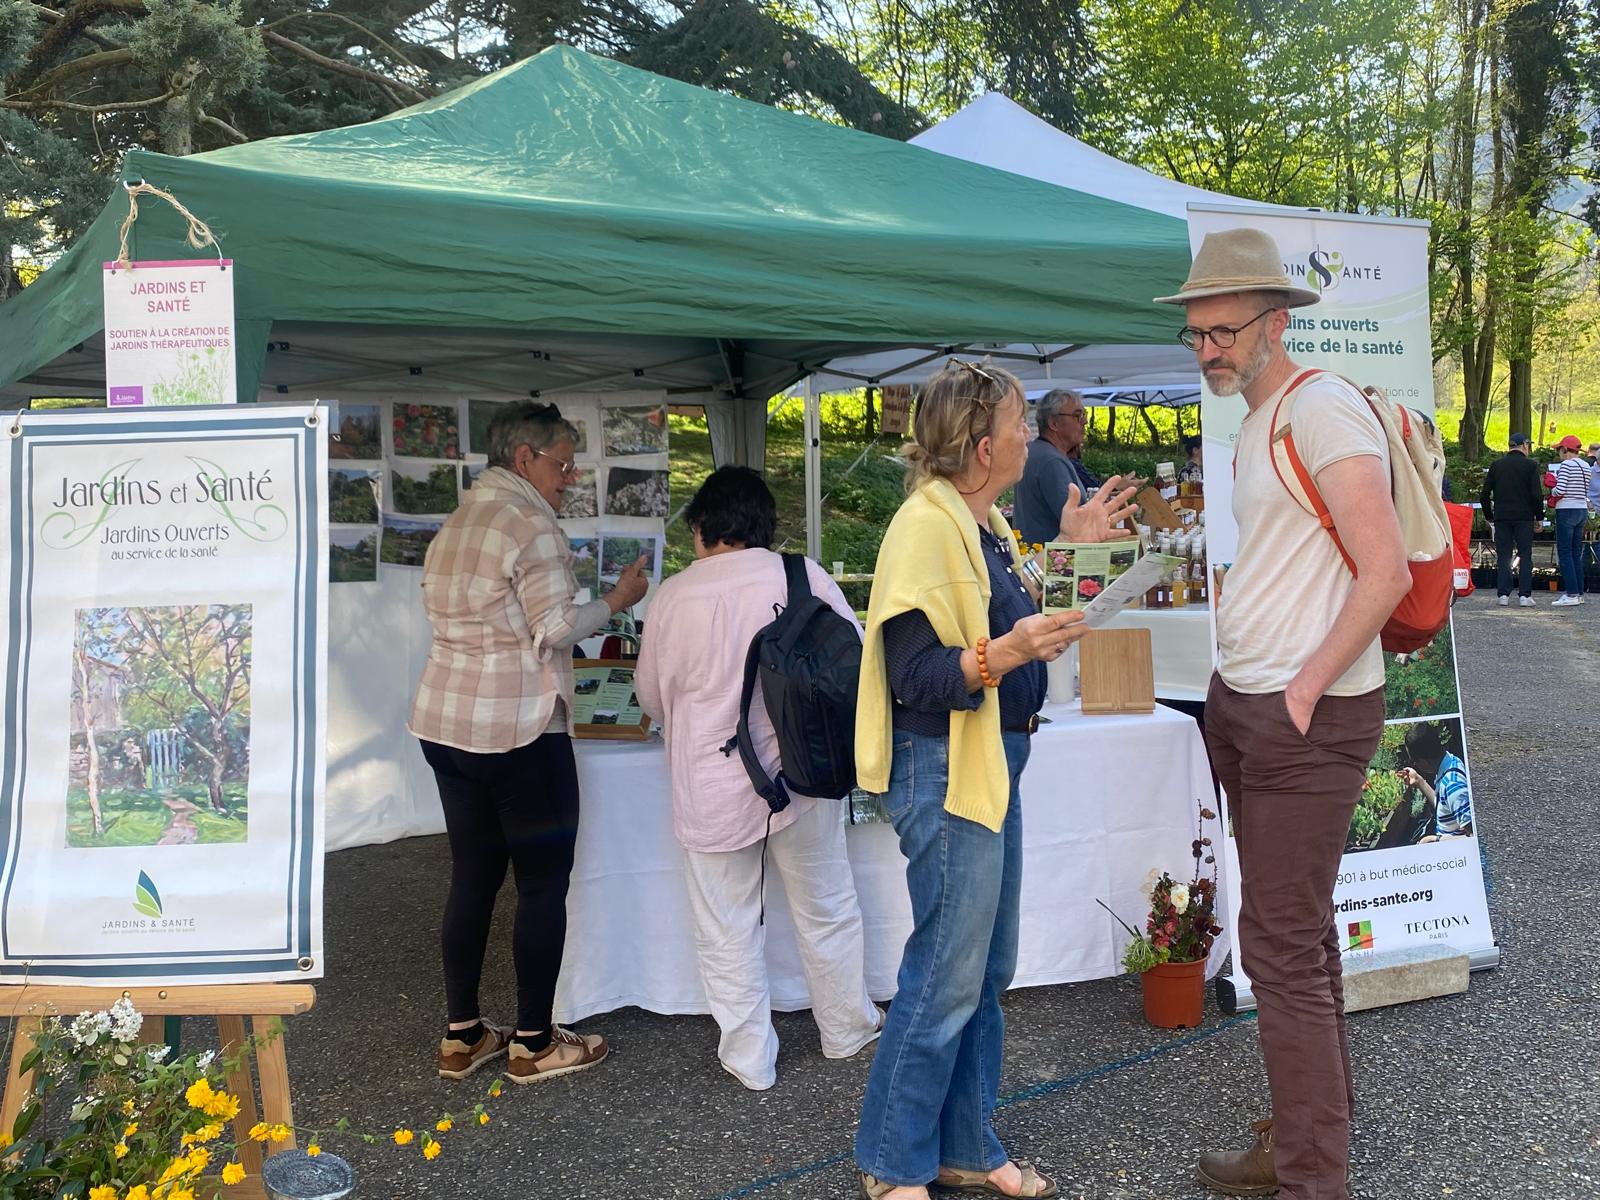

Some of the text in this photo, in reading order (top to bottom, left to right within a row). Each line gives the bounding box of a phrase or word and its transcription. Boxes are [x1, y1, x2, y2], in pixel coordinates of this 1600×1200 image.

[131, 280, 206, 295] JARDINS ET
[147, 296, 190, 313] SANTÉ
[110, 325, 230, 339] SOUTIEN À LA CRÉATION DE
[1320, 318, 1380, 332] ouverts
[111, 338, 230, 351] JARDINS THÉRAPEUTIQUES
[1320, 338, 1341, 353] de
[1345, 339, 1358, 354] la
[1362, 340, 1404, 355] santé
[1406, 386, 1420, 397] de
[53, 469, 274, 508] Jardins et Santé
[100, 523, 230, 544] Jardins Ouverts
[111, 545, 218, 561] au service de la santé
[1359, 870, 1367, 882] à
[1370, 868, 1389, 881] but
[1392, 856, 1467, 878] médico-social
[102, 917, 195, 929] JARDINS & SANTÉ
[1404, 914, 1471, 934] TECTONA
[1429, 932, 1449, 940] PARIS
